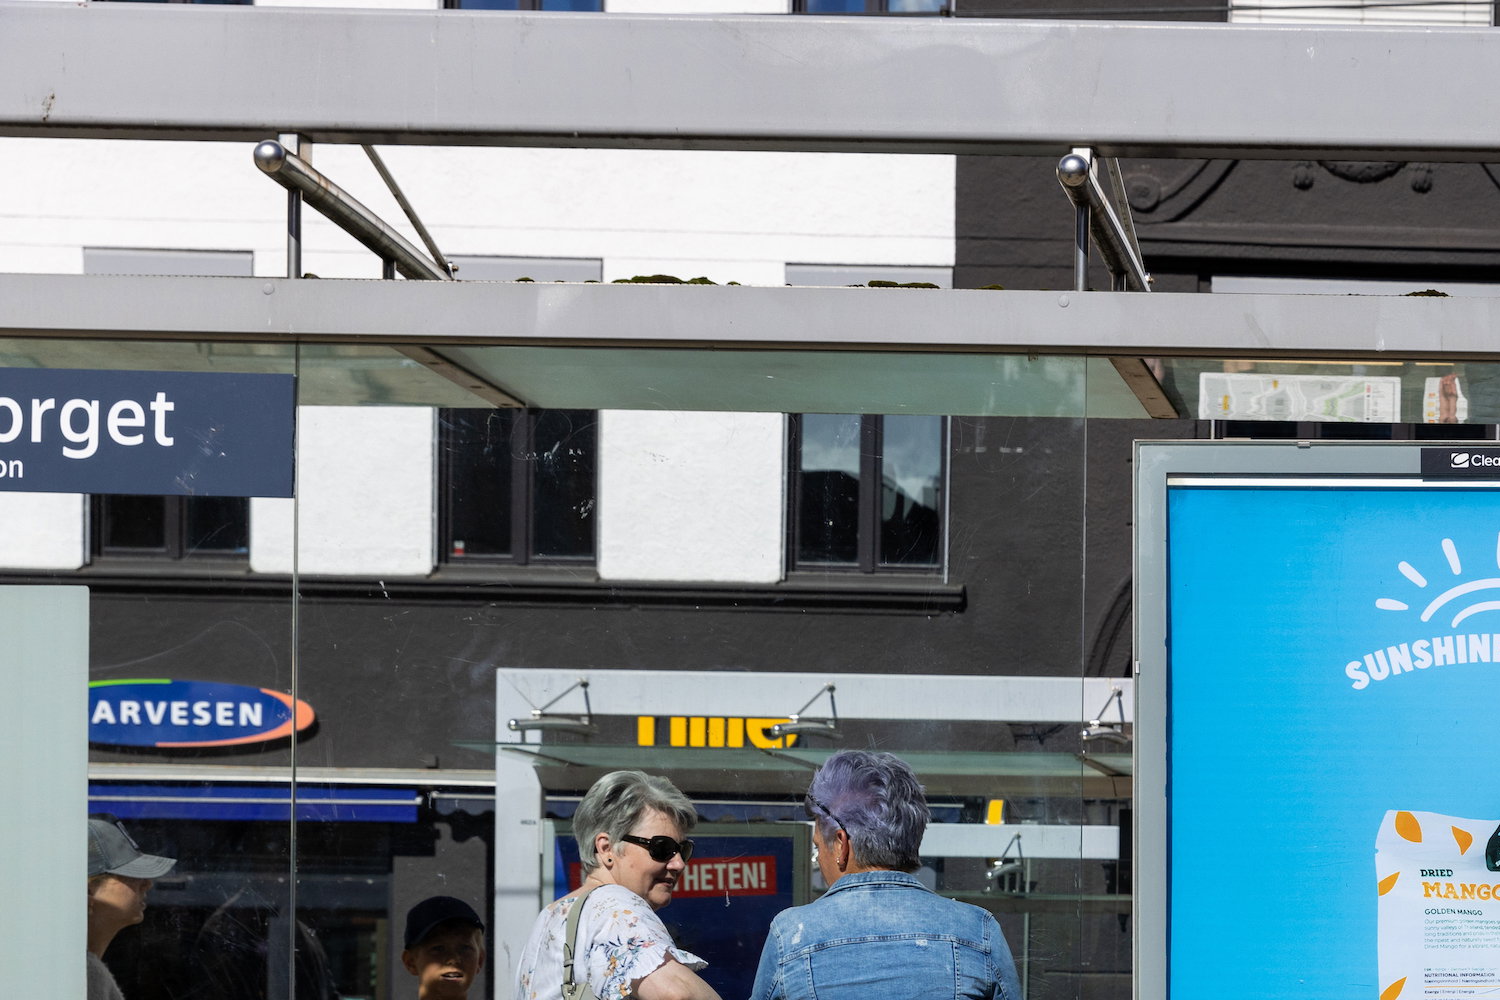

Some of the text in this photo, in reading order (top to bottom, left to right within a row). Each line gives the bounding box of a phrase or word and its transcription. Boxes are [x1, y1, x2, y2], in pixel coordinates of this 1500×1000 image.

[91, 700, 263, 727] ARVESEN
[673, 862, 767, 891] HETEN!
[1420, 868, 1454, 878] DRIED
[1424, 907, 1483, 917] GOLDEN MANGO
